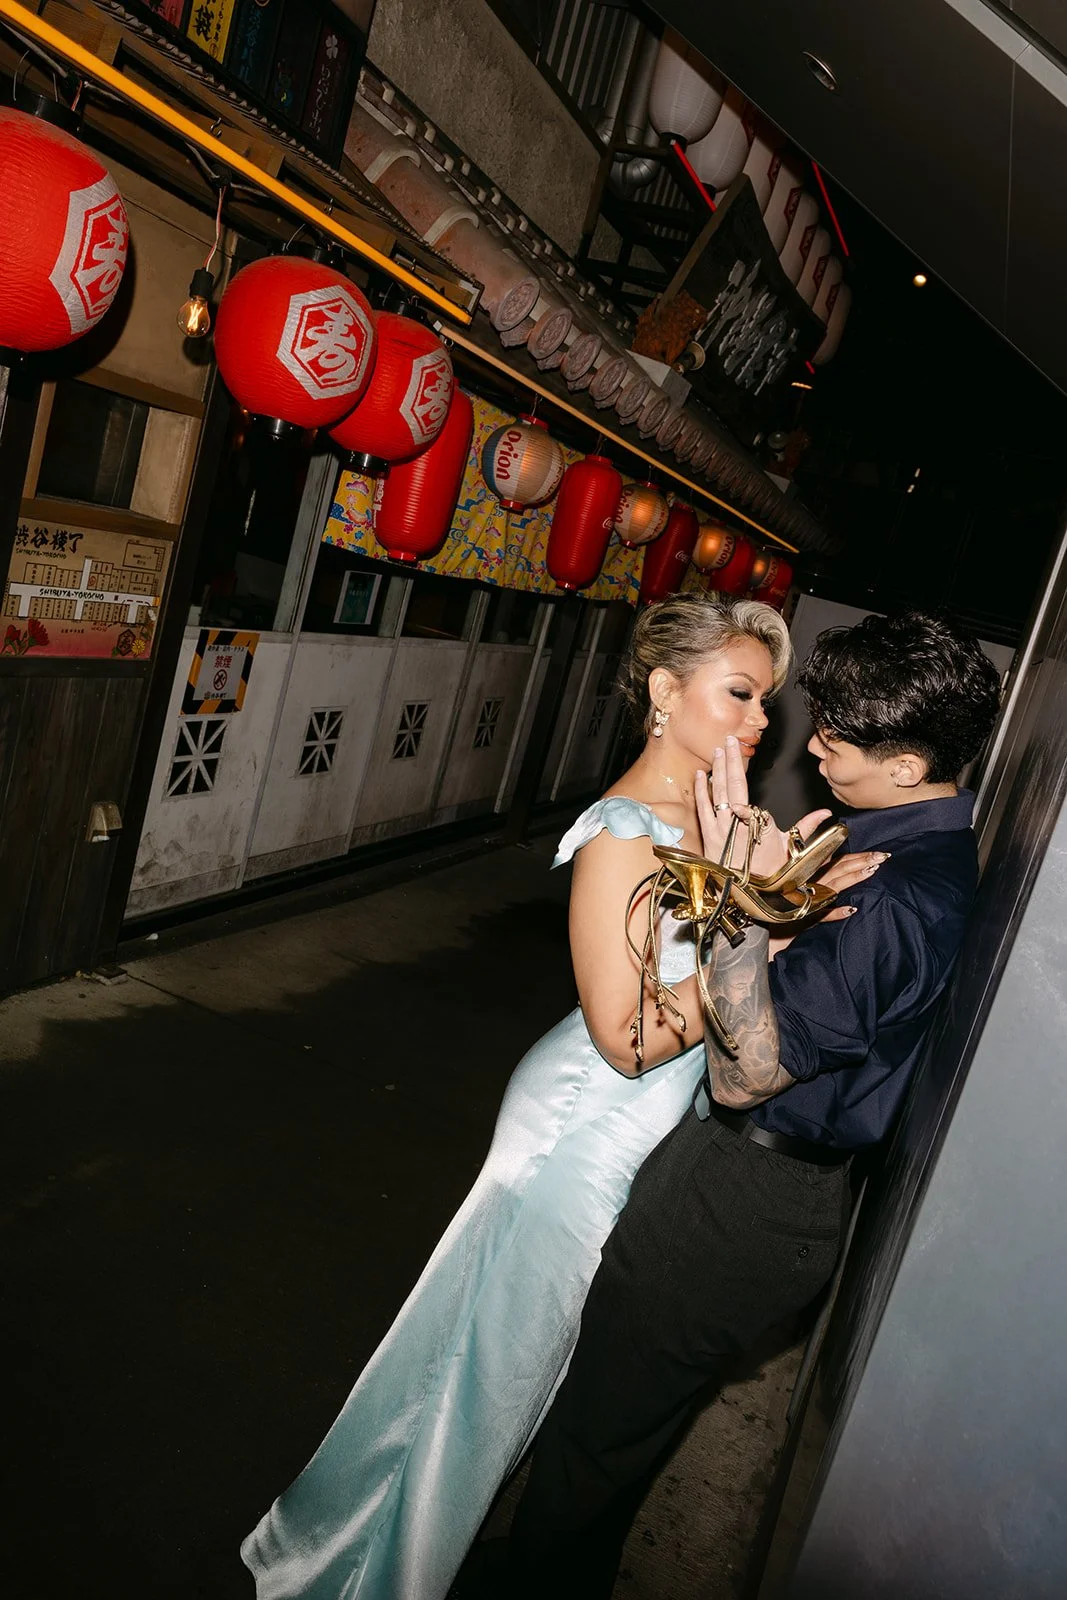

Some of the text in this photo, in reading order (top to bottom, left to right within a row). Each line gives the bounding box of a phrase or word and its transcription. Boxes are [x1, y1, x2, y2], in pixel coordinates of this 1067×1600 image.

[496, 430, 522, 480] Orion
[16, 547, 67, 559] SHIBUYA-YOKOCHO
[716, 535, 733, 565] Orion
[39, 588, 105, 601] SHIBUYA-YOKOCHO
[214, 655, 232, 668] 禁煙
